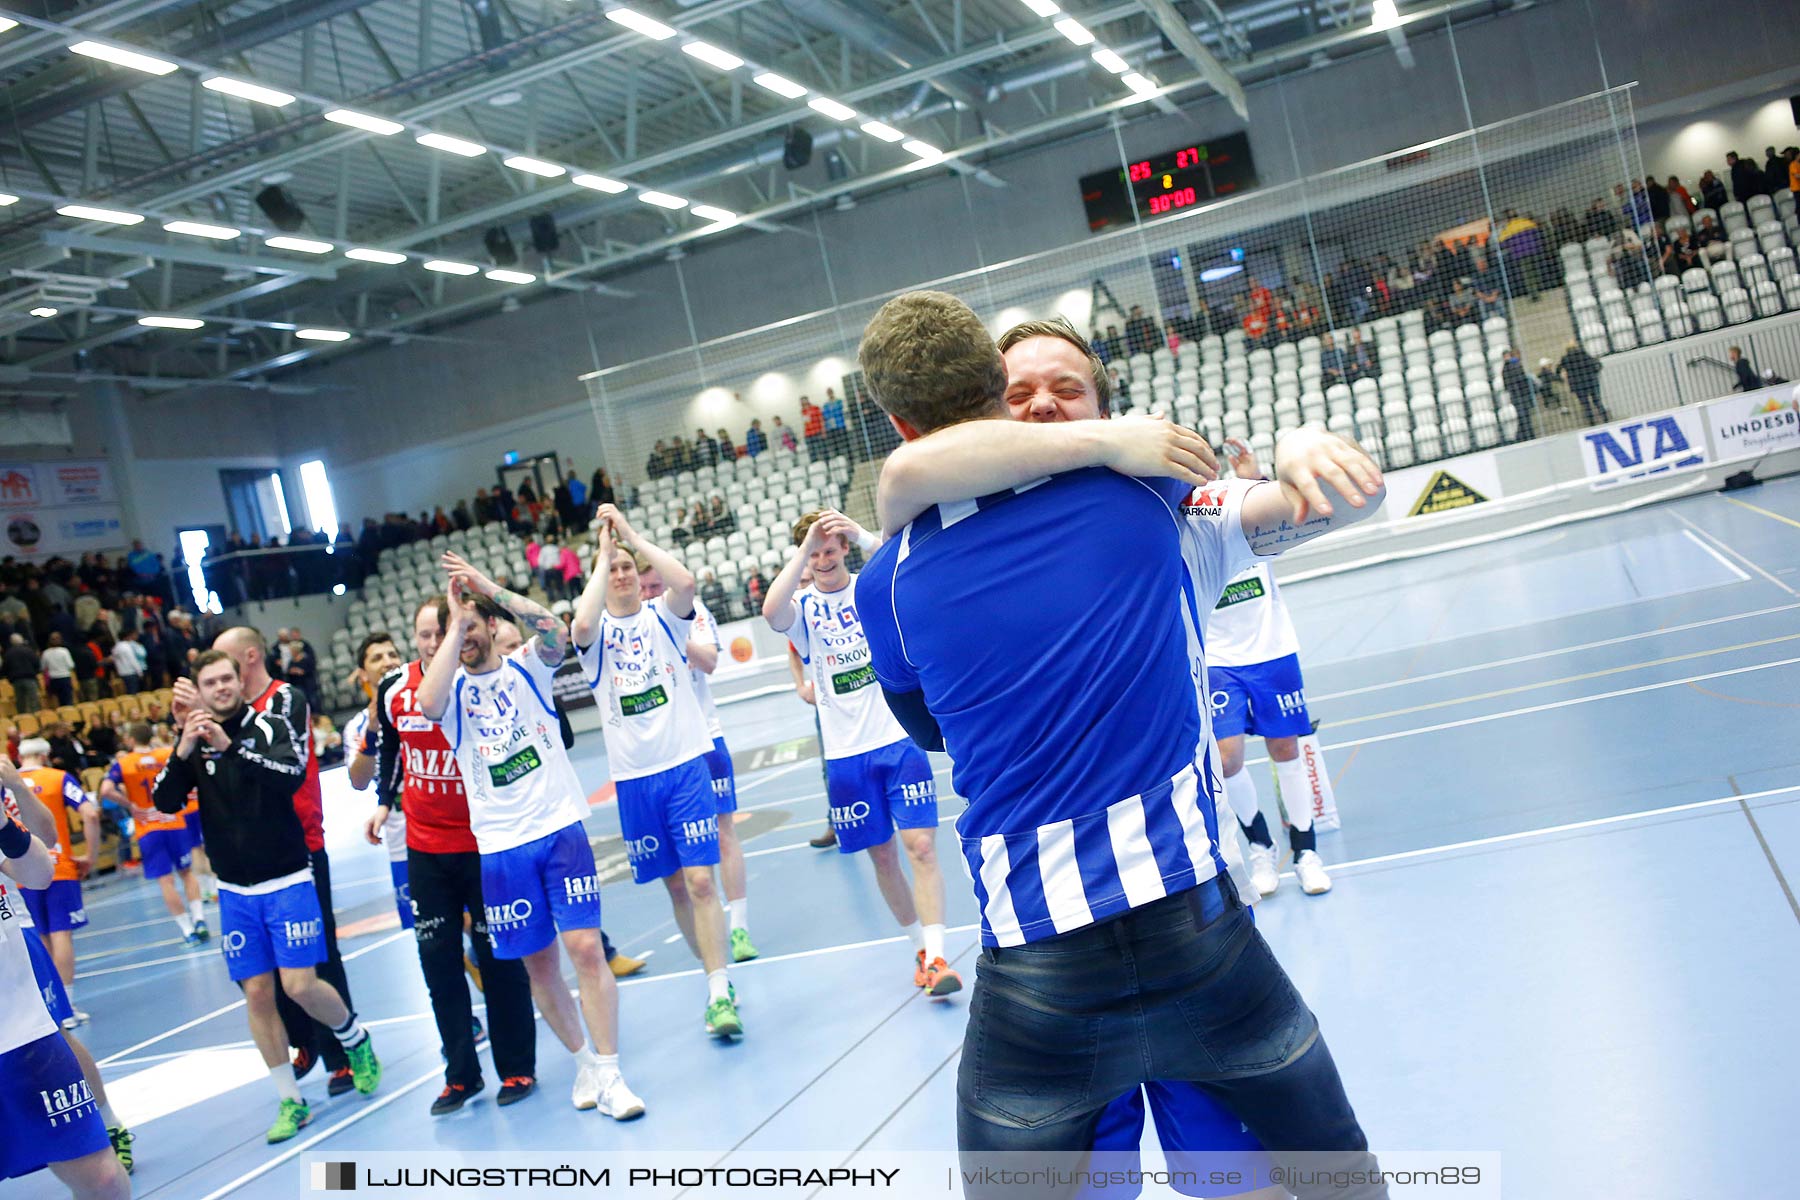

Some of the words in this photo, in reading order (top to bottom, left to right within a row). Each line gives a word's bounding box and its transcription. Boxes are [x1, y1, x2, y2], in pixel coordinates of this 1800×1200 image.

[1129, 161, 1152, 182] 25
[1176, 147, 1199, 169] 27
[1585, 415, 1704, 485] NA
[469, 685, 480, 705] 3
[205, 760, 216, 775] 9
